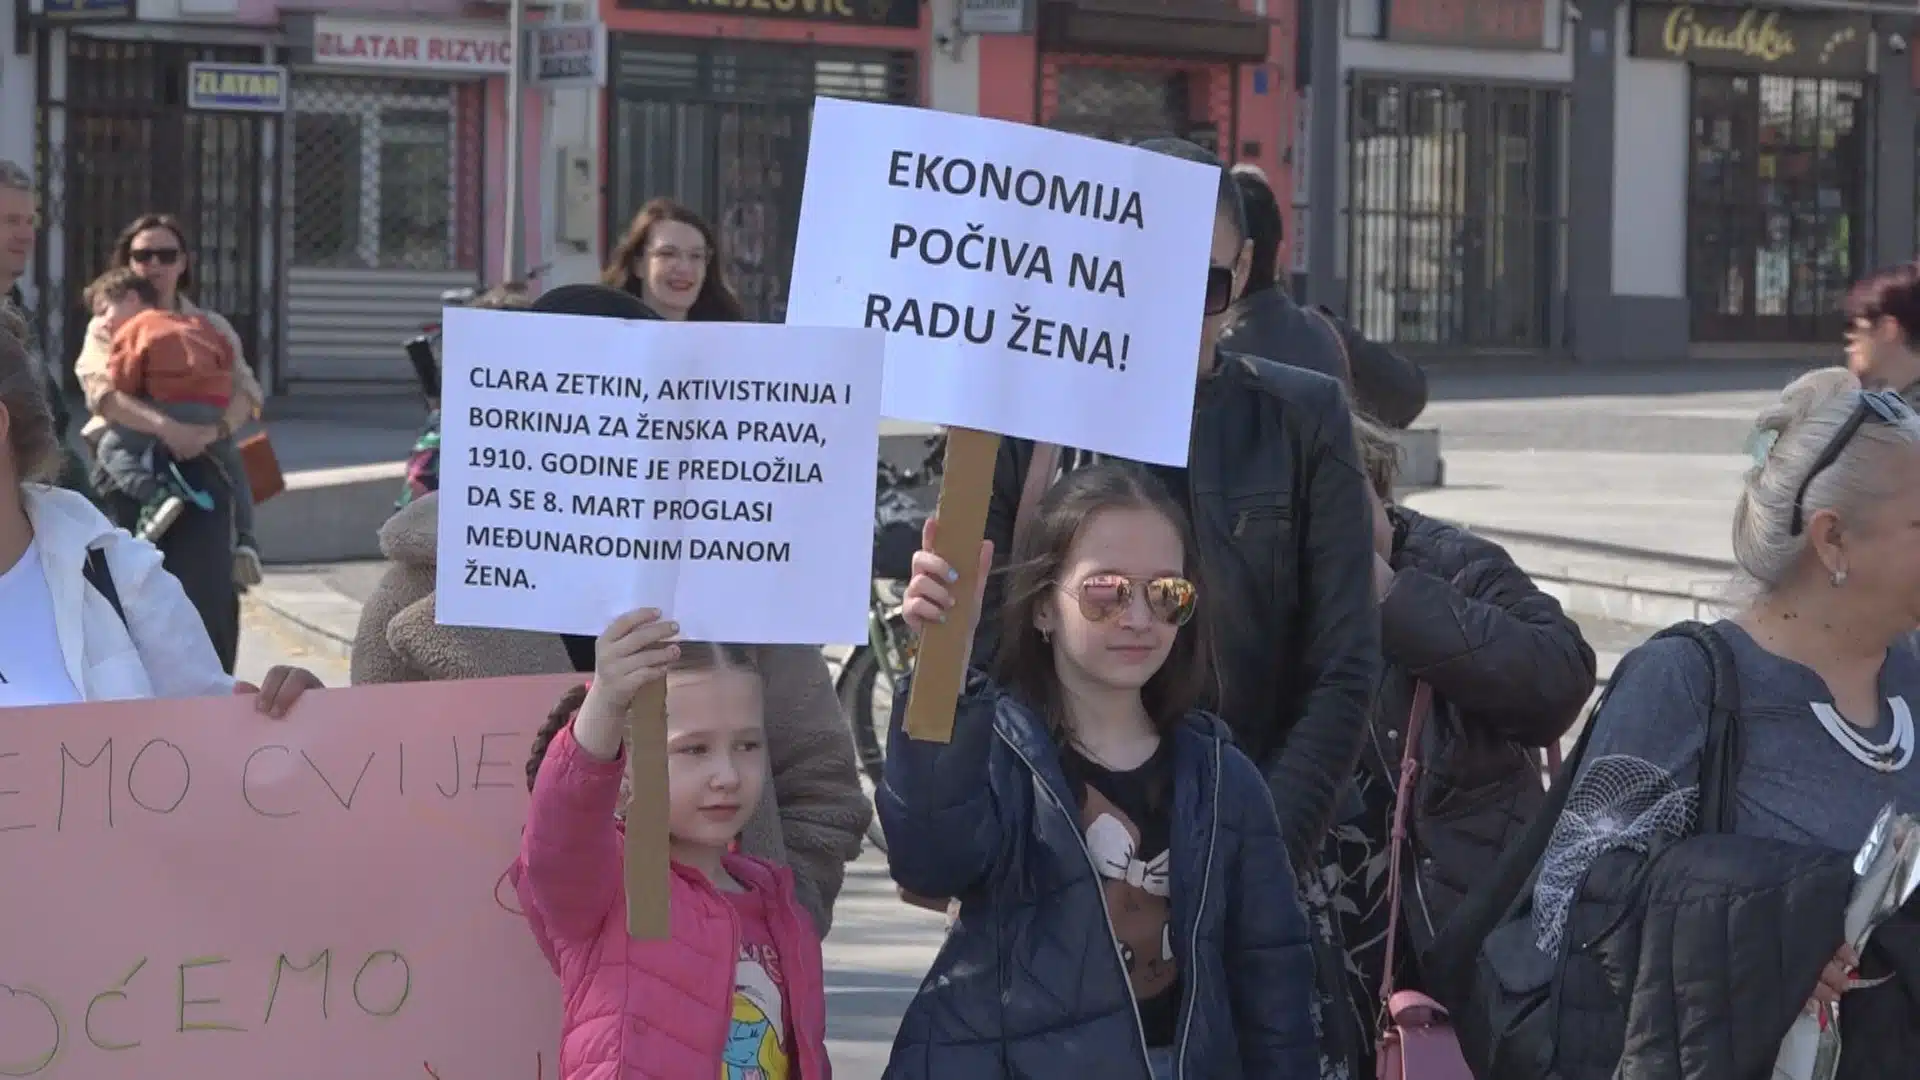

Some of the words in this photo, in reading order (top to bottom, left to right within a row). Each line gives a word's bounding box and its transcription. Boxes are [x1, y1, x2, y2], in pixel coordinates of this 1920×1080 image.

[318, 32, 419, 61] ZLATAR
[195, 71, 278, 96] ZLATAR
[888, 150, 1145, 230] EKONOMIJA
[890, 222, 1053, 284] POČIVA
[1068, 252, 1126, 299] NA
[864, 293, 996, 344] RADU
[1006, 303, 1130, 372] ŽENA!
[469, 367, 549, 393] CLARA
[555, 372, 649, 403] ZETKIN,
[657, 378, 837, 405] AKTIVISTKINJA
[844, 384, 851, 405] I
[469, 406, 591, 436] BORKINJA
[598, 415, 629, 438] ZA
[635, 412, 729, 441] ŽENSKA
[737, 420, 826, 448] PRAVA,
[468, 446, 533, 471] 1910.
[541, 452, 639, 479] GODINE
[644, 459, 670, 481] JE
[678, 456, 823, 483] PREDLOŽILA
[467, 485, 501, 509] DA
[509, 489, 536, 511] SE
[543, 491, 564, 513] 8.
[572, 494, 646, 520] MART
[653, 498, 773, 523] PROGLASI
[466, 525, 683, 561] MEĐUNARODNIM
[689, 539, 790, 563] DANOM
[464, 559, 537, 590] ŽENA.
